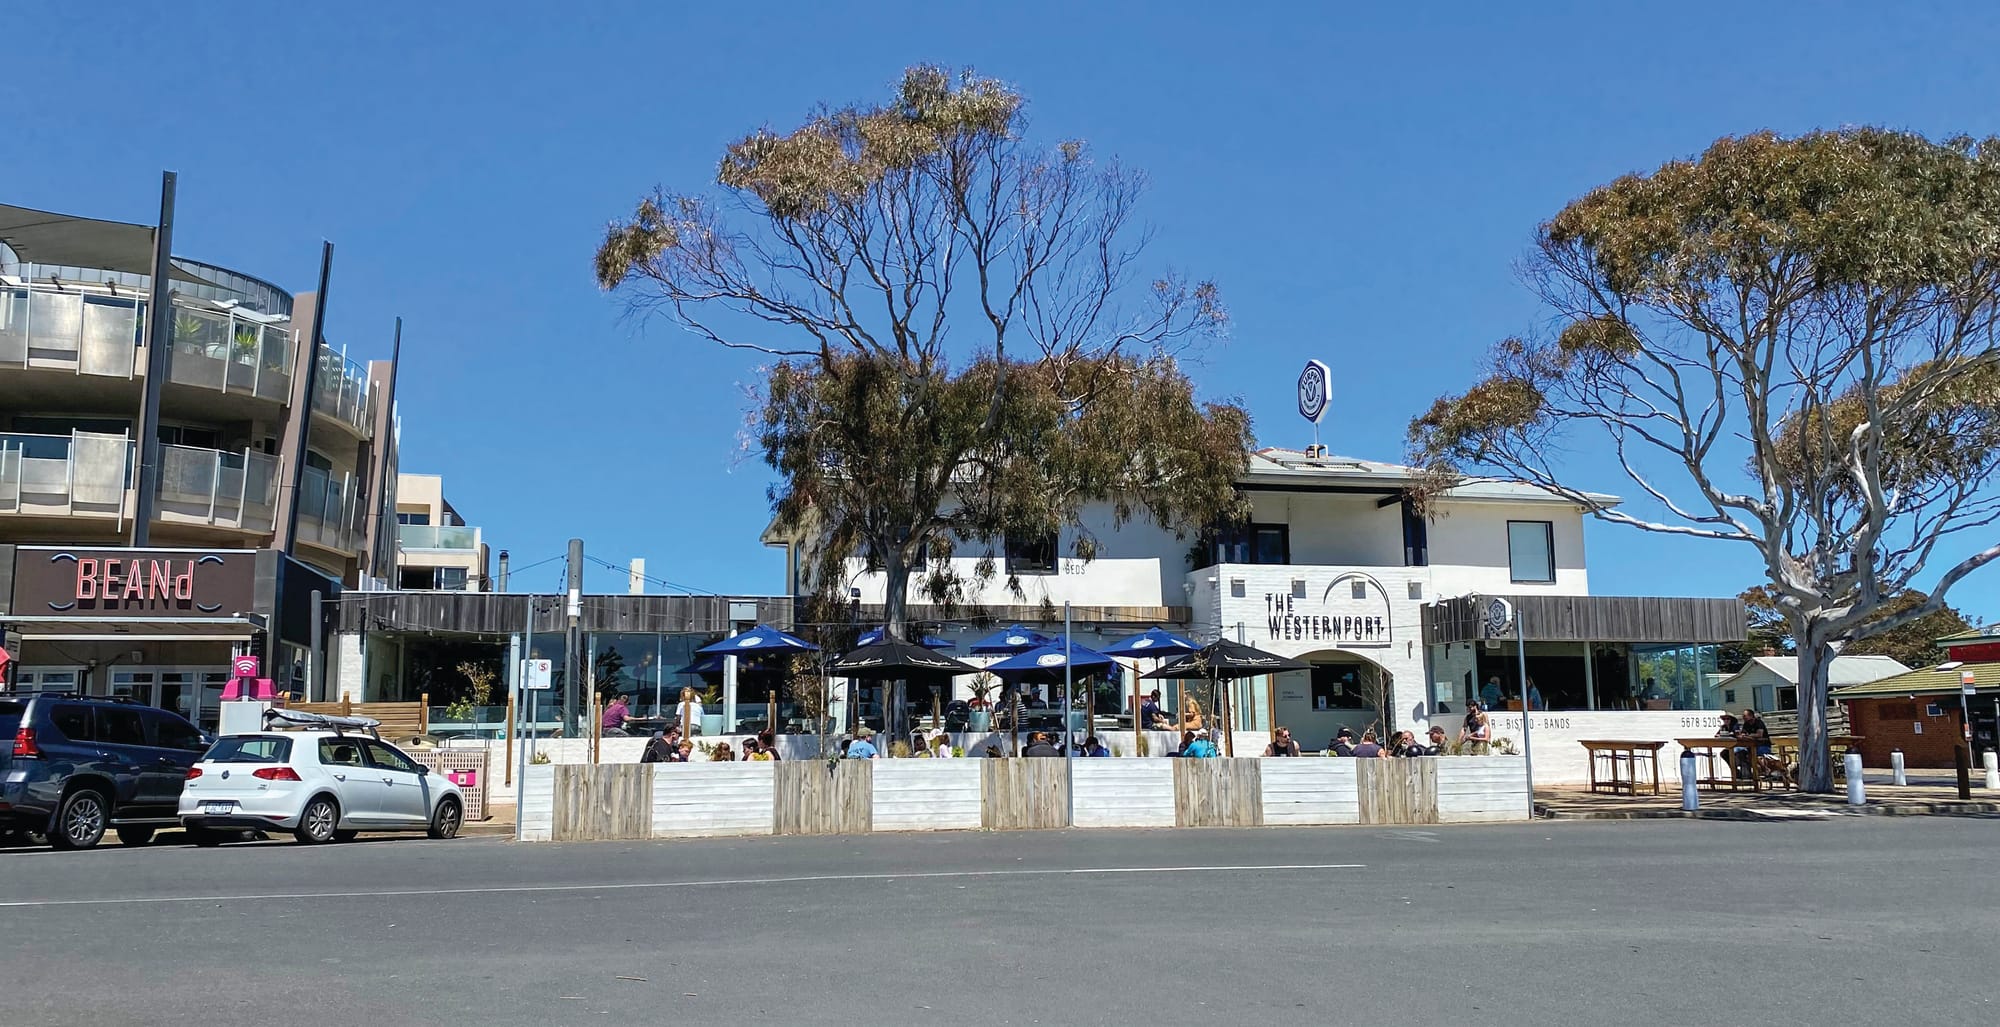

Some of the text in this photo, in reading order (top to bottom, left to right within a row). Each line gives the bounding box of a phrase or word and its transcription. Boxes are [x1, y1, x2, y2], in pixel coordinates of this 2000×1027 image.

[1265, 593, 1295, 613] THE
[1267, 616, 1382, 637] WESTERNPORT
[1507, 718, 1534, 730] BISTO
[1544, 718, 1570, 729] BANDS
[1681, 717, 1700, 728] 5678
